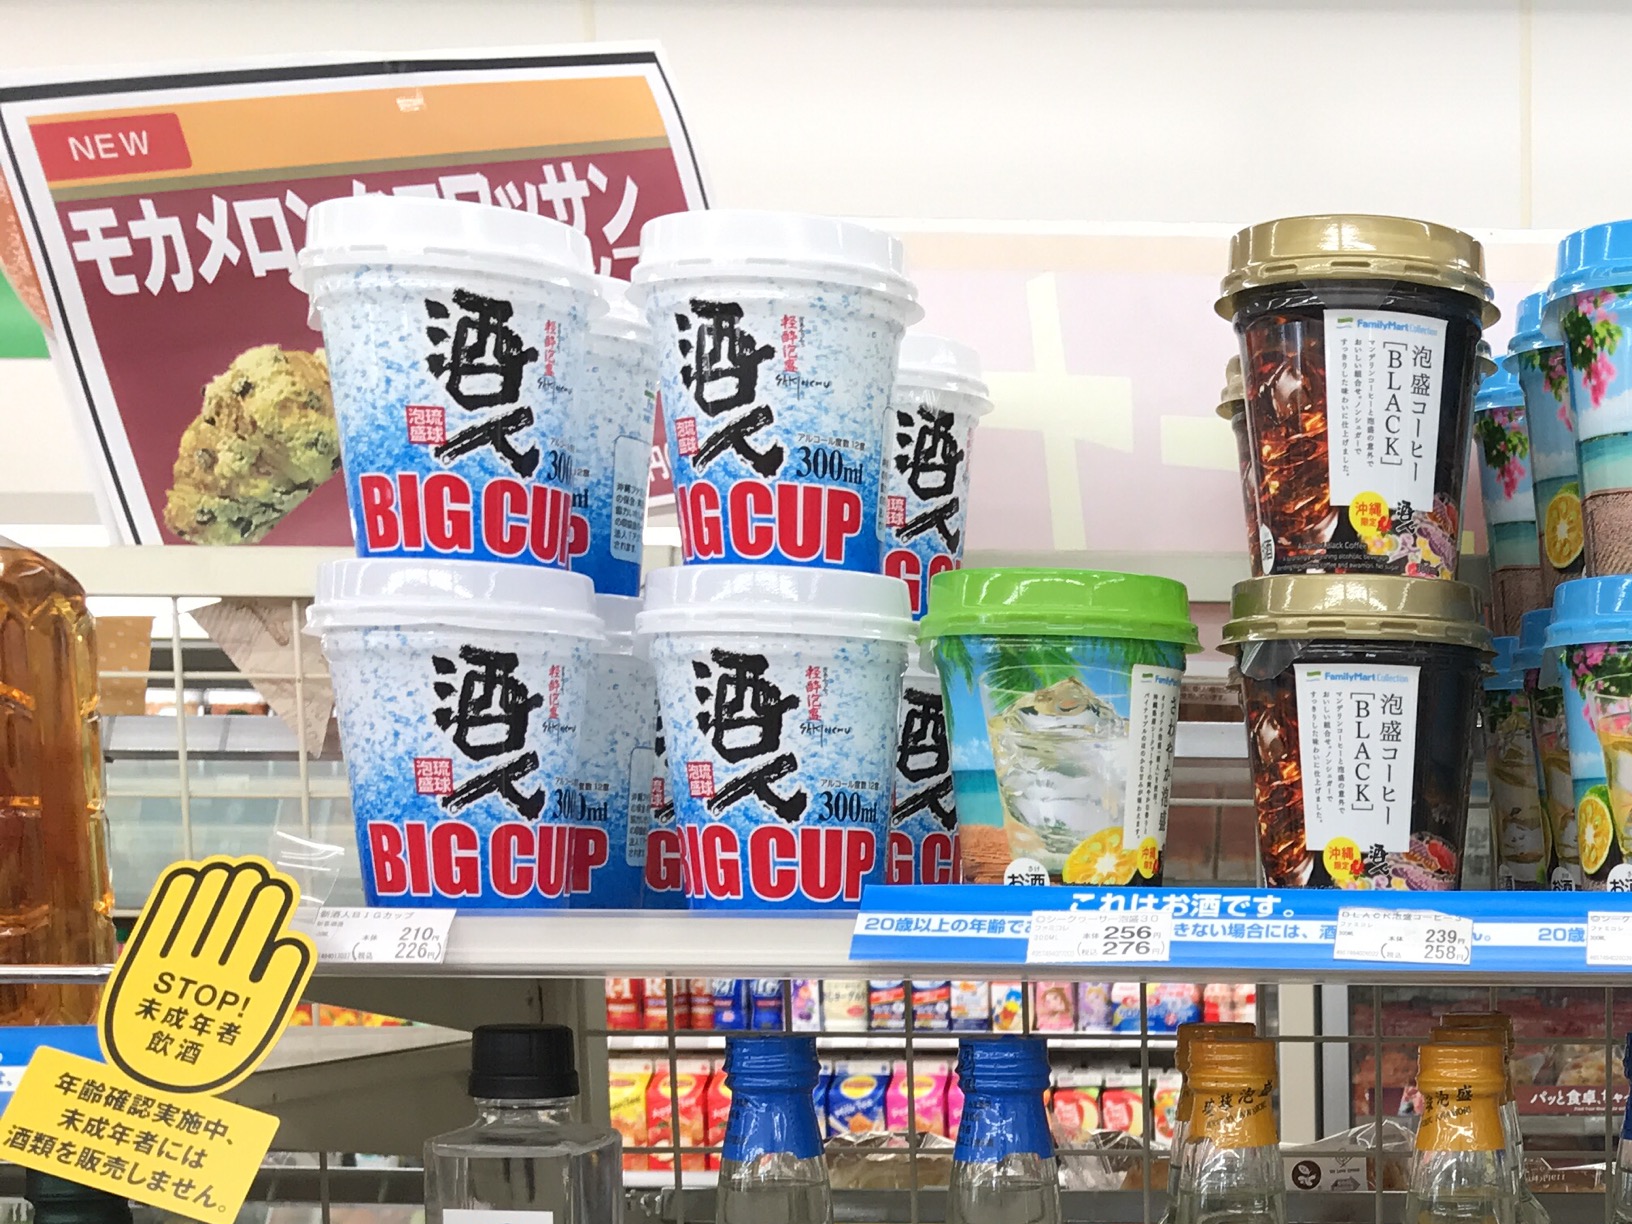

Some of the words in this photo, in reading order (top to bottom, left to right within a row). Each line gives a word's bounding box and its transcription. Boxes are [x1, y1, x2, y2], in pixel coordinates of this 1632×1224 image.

[68, 129, 151, 161] NEW
[1357, 319, 1409, 331] FamilyMart
[1411, 345, 1432, 481] 泡盛コーヒー
[796, 446, 862, 484] 300ml
[360, 472, 473, 552] BIG
[728, 480, 862, 564] CUP
[1355, 502, 1382, 517] 沖縄
[1325, 672, 1376, 681] FamilyMart
[1380, 694, 1403, 825] 泡盛コーヒー
[819, 791, 877, 822] 300ml
[368, 821, 482, 897] BIG
[749, 824, 876, 902] CUP
[1329, 846, 1354, 860] 沖縄
[153, 971, 252, 1019] STOP!
[134, 998, 243, 1047] 未成年者
[145, 1032, 206, 1066] 飲酒
[54, 1071, 235, 1146] 年齢確認実施中、
[59, 1108, 209, 1170] 未成年者には
[2, 1124, 229, 1215] 酒類を販売しません。
